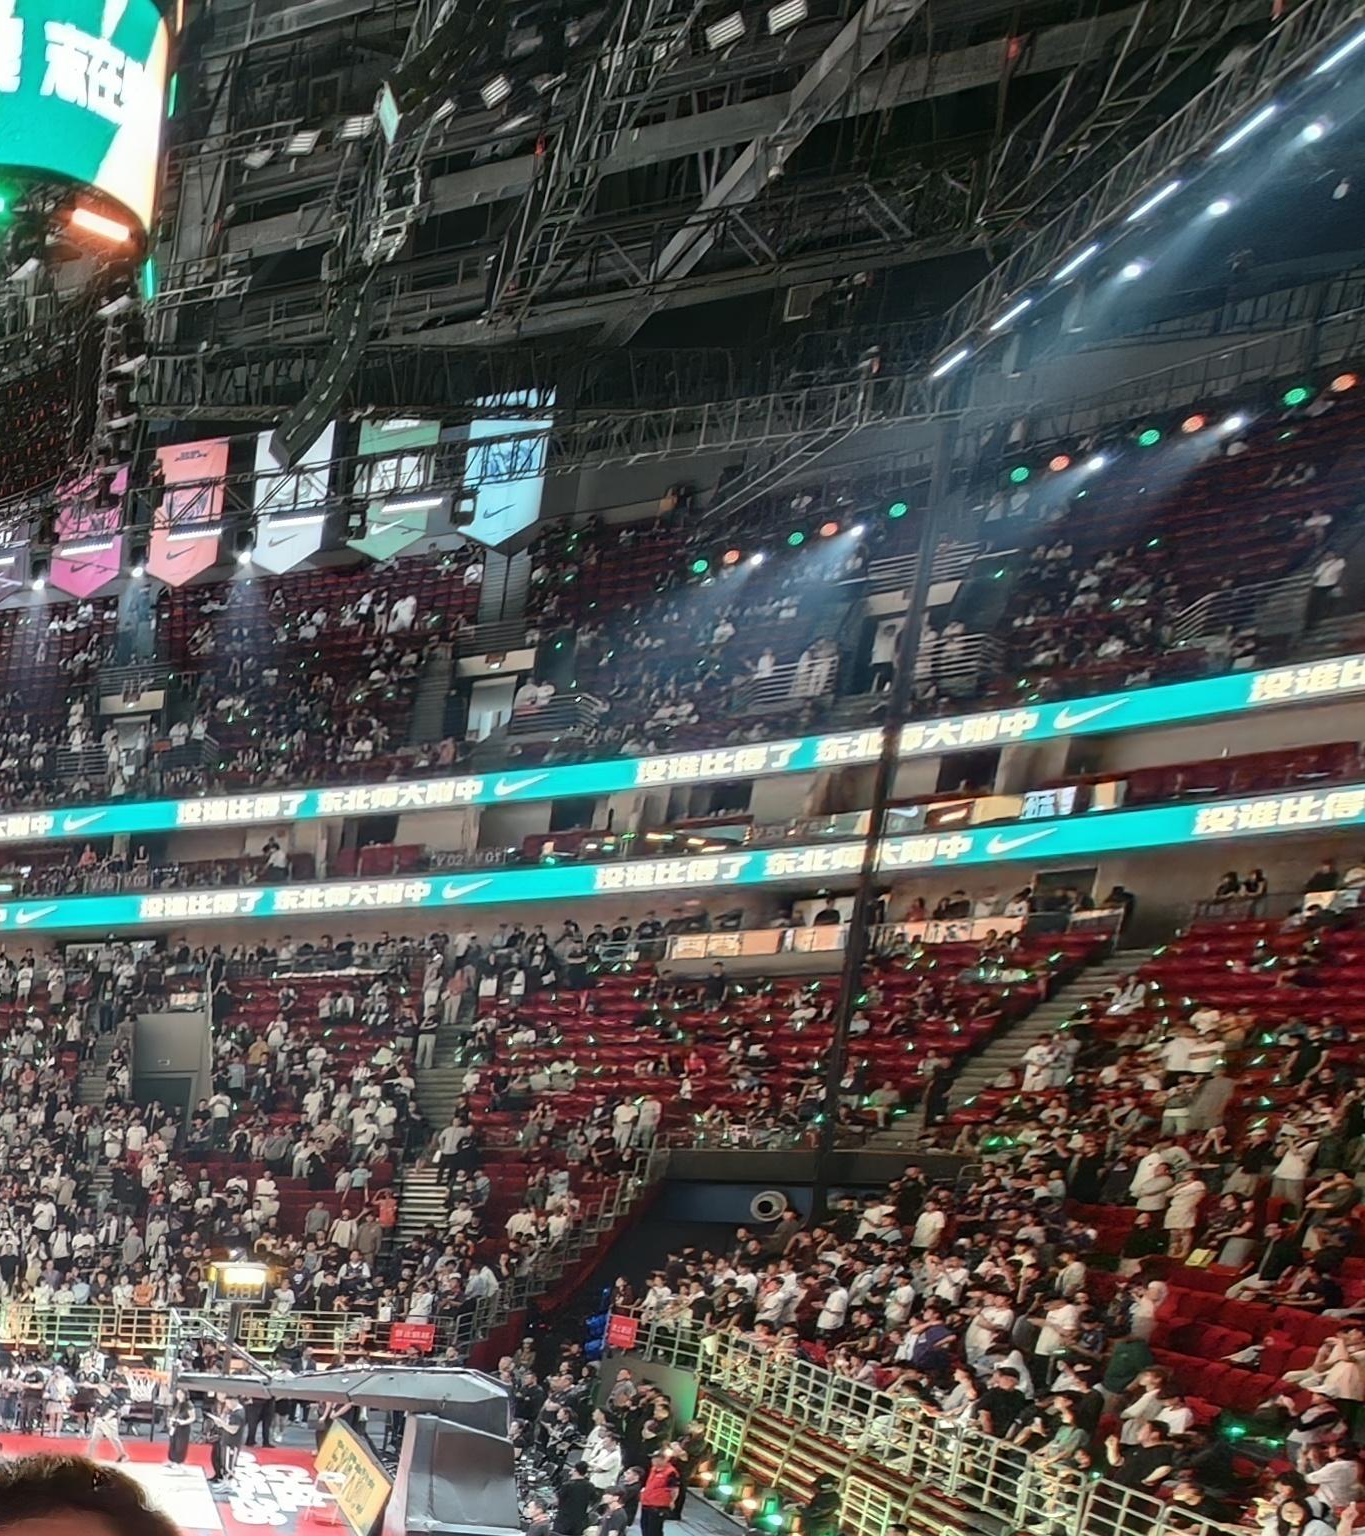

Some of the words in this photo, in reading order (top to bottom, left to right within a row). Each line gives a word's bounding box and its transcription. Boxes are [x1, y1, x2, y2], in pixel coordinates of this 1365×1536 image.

[636, 743, 802, 784] 没谁比得了
[177, 794, 307, 825] 没谁比得了
[317, 779, 484, 812] 东北师大附中
[595, 857, 751, 889] 没谁比得了
[140, 892, 263, 918] 没谁比得了
[274, 882, 431, 910] 东北师大附中
